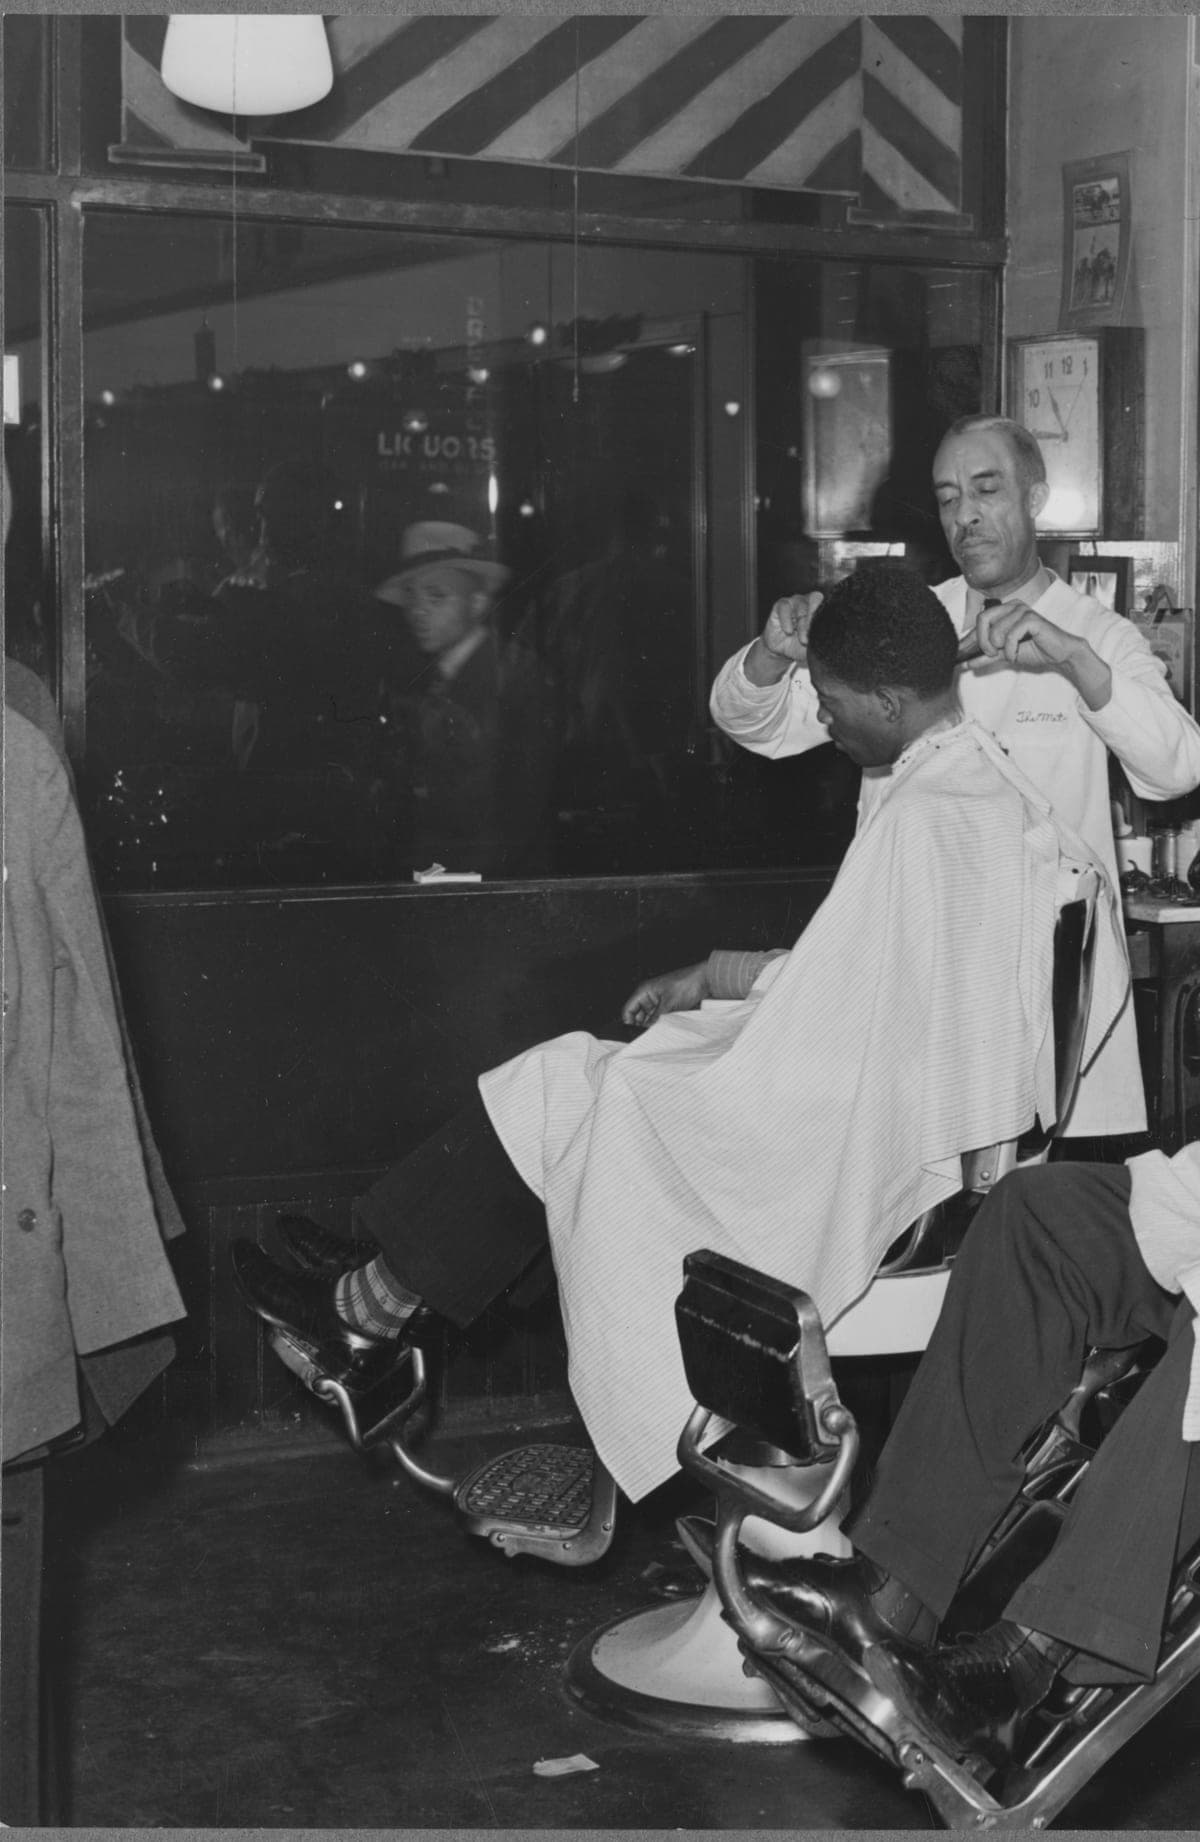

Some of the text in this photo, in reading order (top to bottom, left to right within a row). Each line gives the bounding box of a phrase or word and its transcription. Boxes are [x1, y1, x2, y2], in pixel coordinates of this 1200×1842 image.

[1044, 361, 1054, 379] 11
[1062, 355, 1073, 375] 12
[1028, 388, 1040, 408] 10
